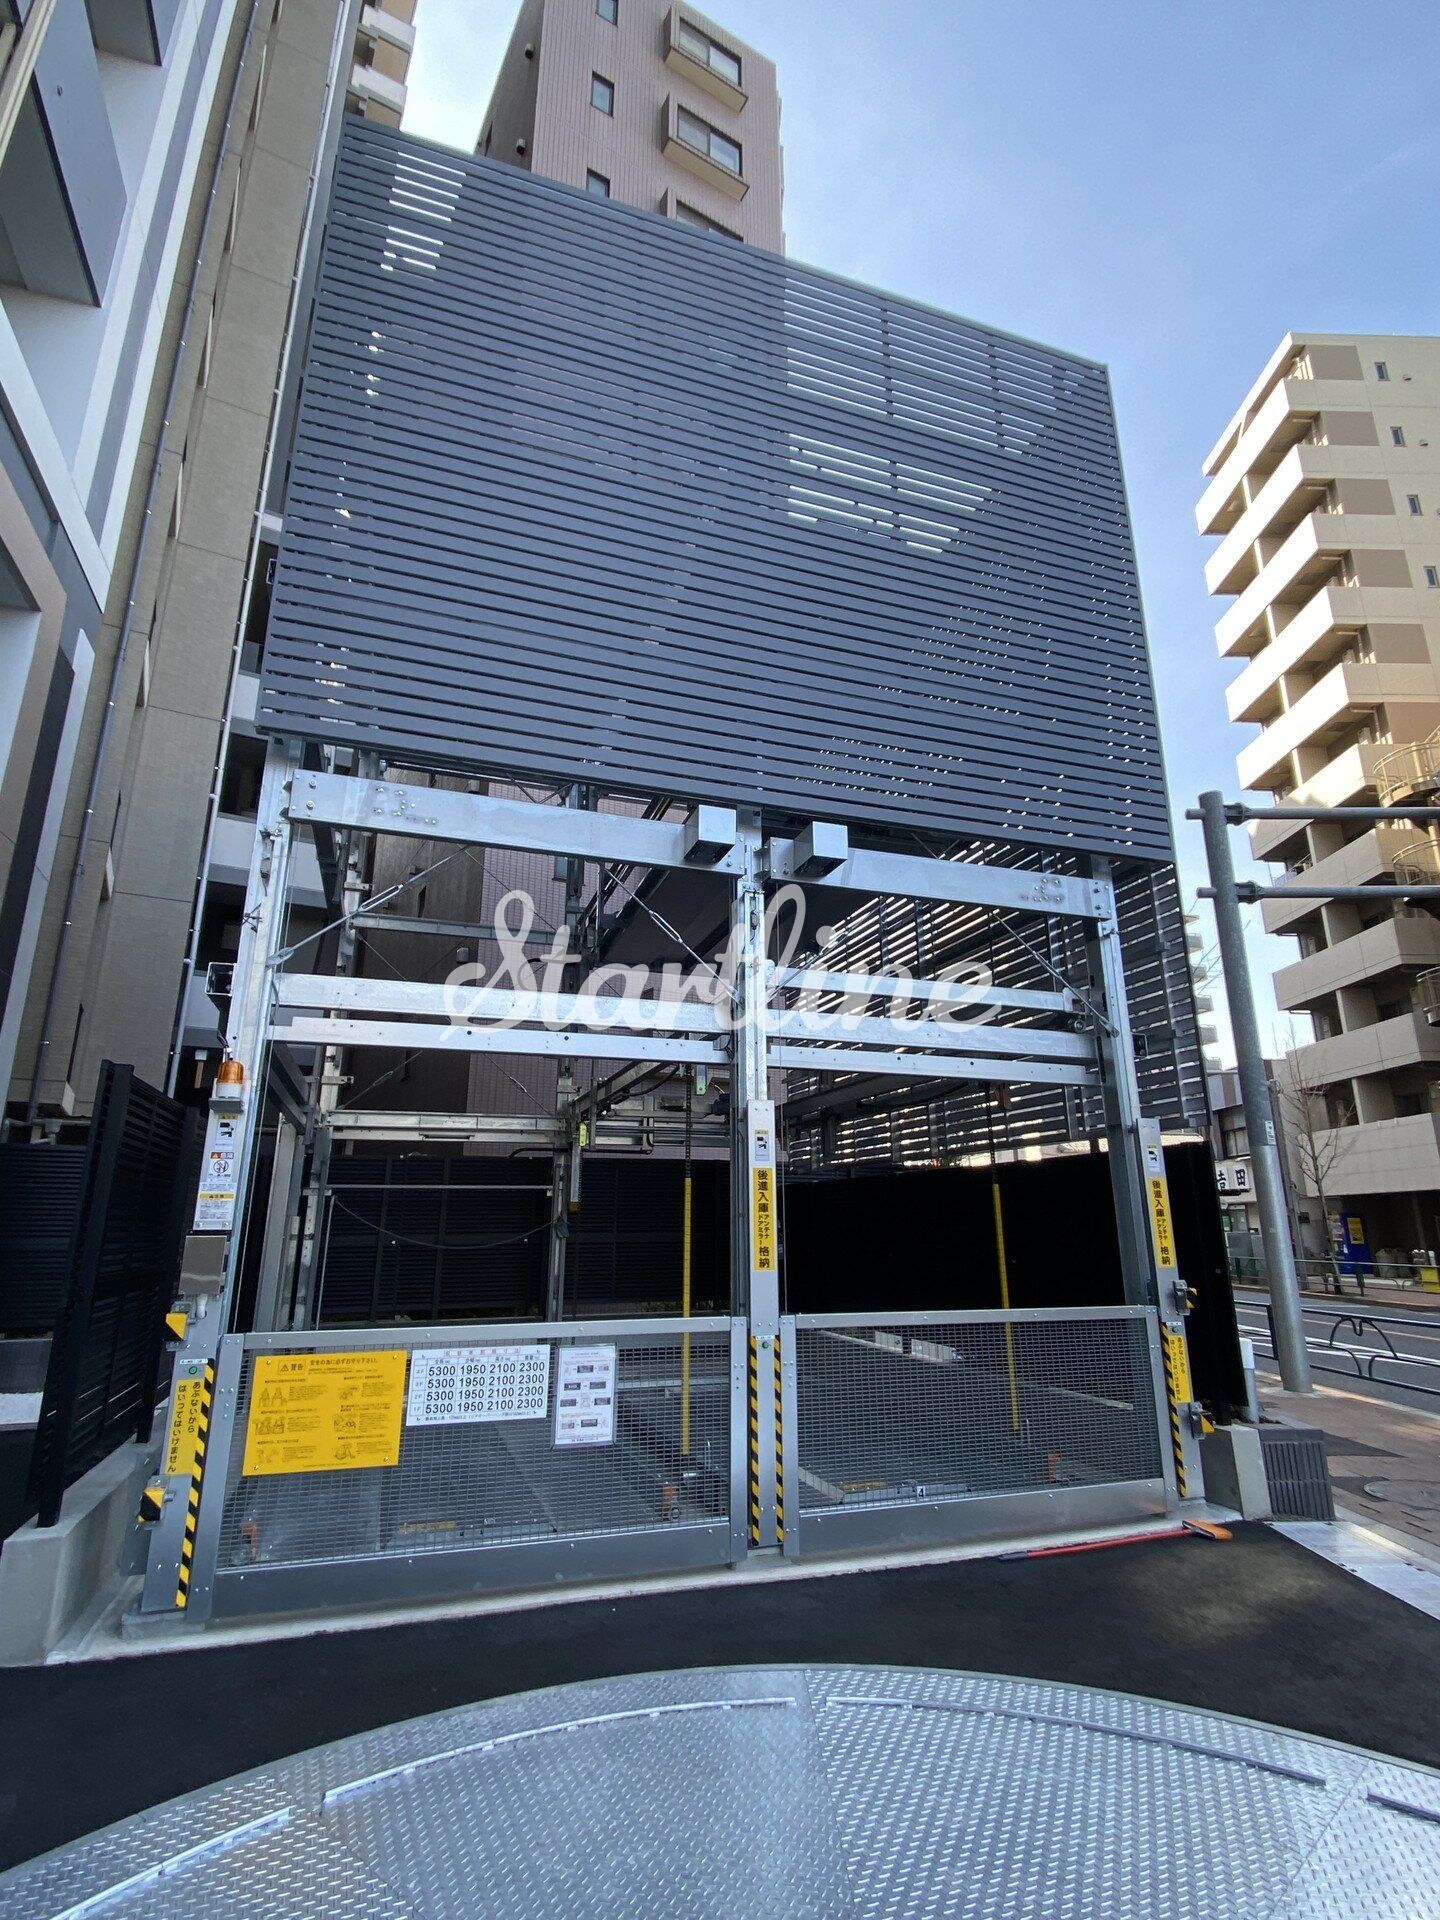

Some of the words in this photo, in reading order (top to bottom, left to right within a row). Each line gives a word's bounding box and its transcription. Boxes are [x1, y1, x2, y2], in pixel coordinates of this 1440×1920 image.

[757, 1169, 769, 1213] 後進入庫
[758, 1246, 770, 1269] 格納
[428, 1365, 456, 1377] 5300
[460, 1364, 486, 1375] 1950
[490, 1362, 516, 1374] 2100
[519, 1361, 545, 1372] 2300
[427, 1377, 455, 1389] 5300
[459, 1376, 485, 1387] 1950
[488, 1375, 515, 1386] 2100
[518, 1373, 545, 1385] 2300
[426, 1389, 454, 1401] 5300
[458, 1388, 485, 1400] 1950
[487, 1387, 515, 1398] 2100
[517, 1386, 544, 1397] 2300
[425, 1402, 453, 1414] 5300
[458, 1401, 484, 1412] 1950
[487, 1399, 514, 1411] 2100
[516, 1398, 543, 1409] 2300
